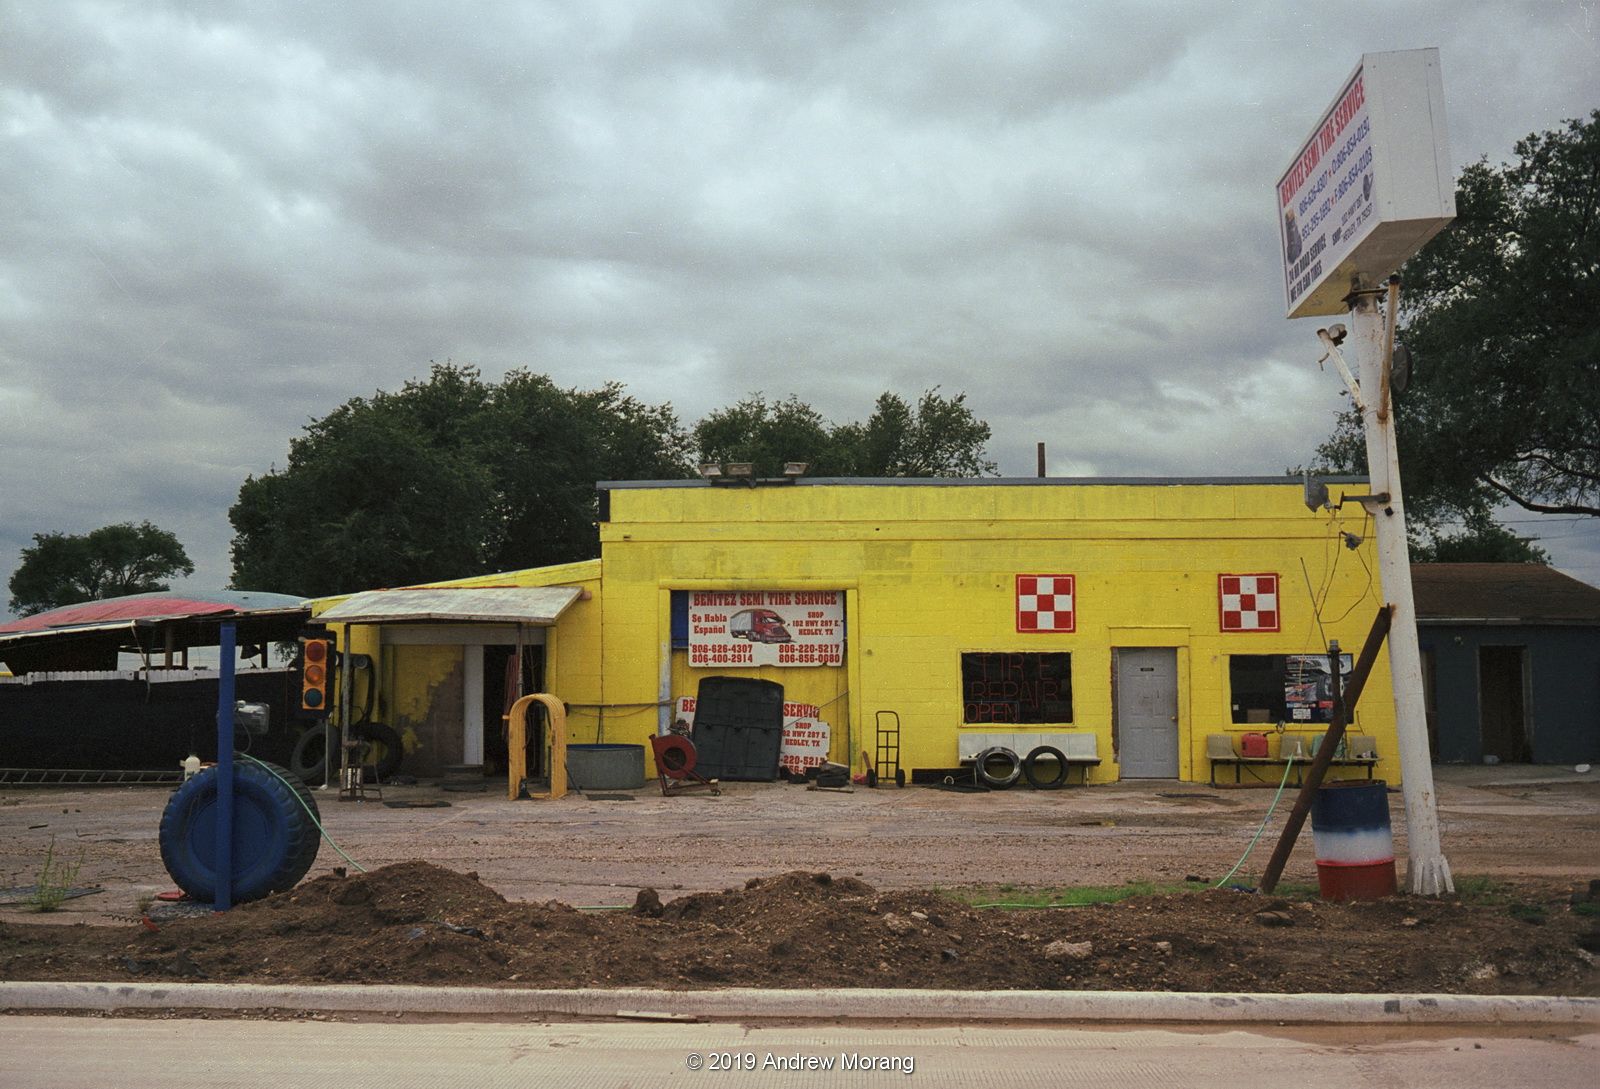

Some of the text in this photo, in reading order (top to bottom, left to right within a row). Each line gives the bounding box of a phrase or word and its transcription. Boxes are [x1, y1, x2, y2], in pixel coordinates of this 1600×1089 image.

[1281, 76, 1365, 208] BENITEZ SEMI TIRE SERVICE
[1299, 251, 1311, 274] ROAD
[1309, 233, 1327, 262] SERVICE
[1302, 271, 1311, 291] CAR
[1310, 259, 1322, 283] TIRES
[693, 591, 837, 607] BENITEZ SEMI TIRE SERVICE
[691, 613, 728, 623] Se Habla
[807, 611, 825, 619] SHOP
[693, 625, 726, 636] Español
[825, 628, 834, 636] TX
[691, 644, 753, 653] 806-626-4307
[778, 644, 840, 653] 806-220-5217
[691, 654, 753, 663] 806-400-2914
[778, 654, 840, 663] 806-856-0080
[976, 652, 1054, 681] TIRE
[971, 680, 1060, 708] REPAIR
[783, 703, 820, 718] SERVIC
[965, 702, 1020, 722] OPEN
[792, 730, 806, 738] HWY
